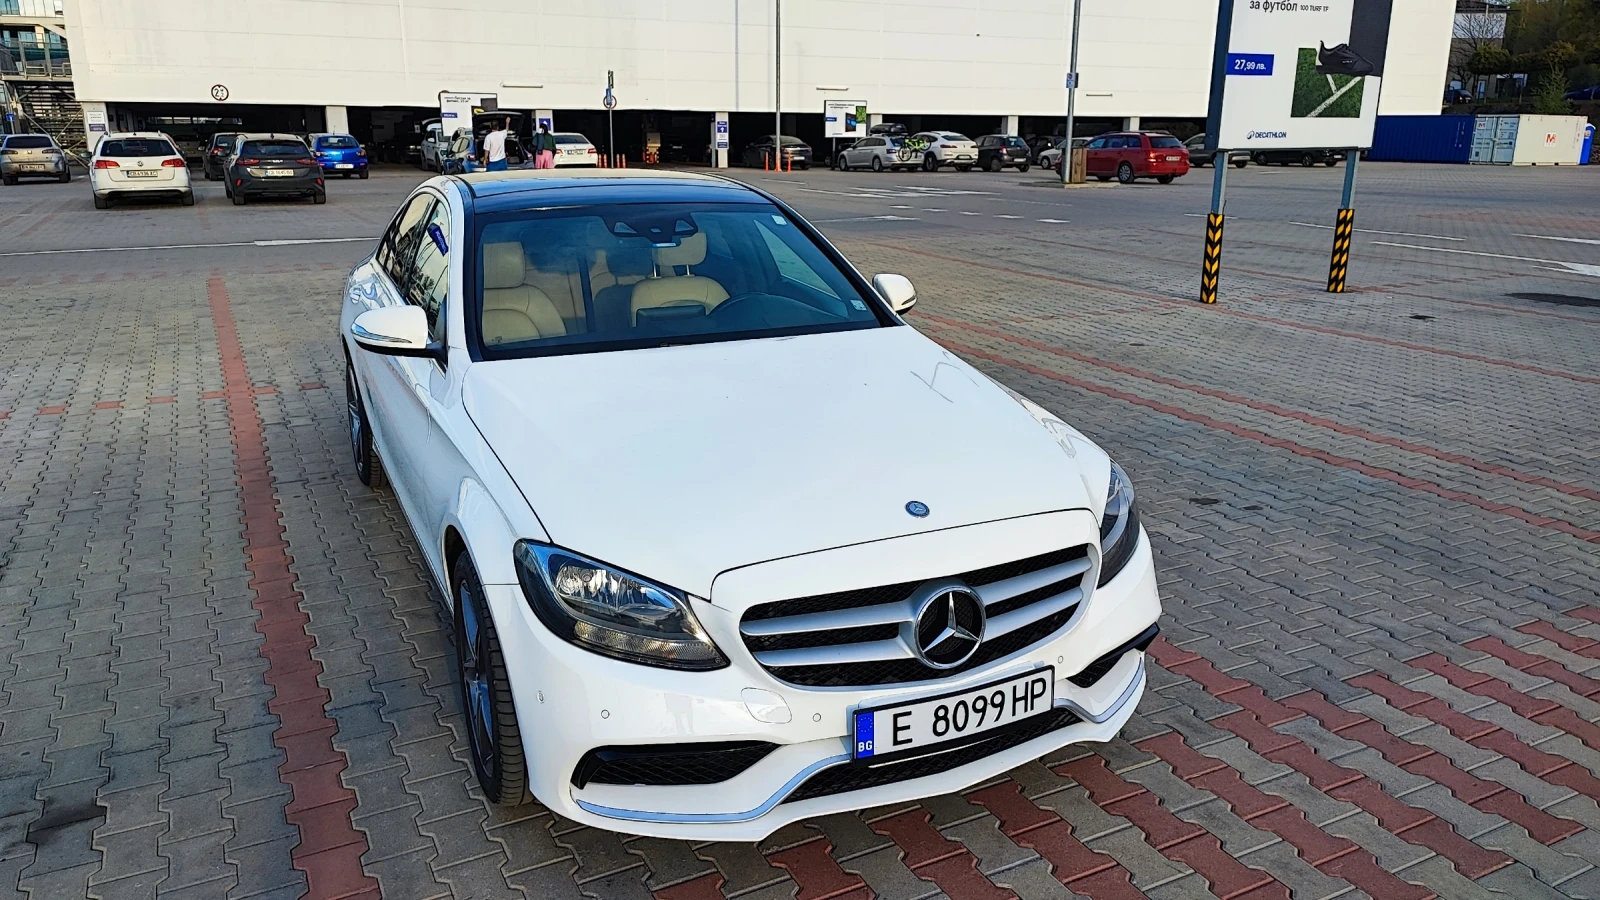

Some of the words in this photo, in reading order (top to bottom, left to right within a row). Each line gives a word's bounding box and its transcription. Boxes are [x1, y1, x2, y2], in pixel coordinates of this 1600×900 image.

[1249, 1, 1260, 9] за
[1262, 0, 1298, 13] футбол
[1234, 59, 1256, 71] 27,99
[1255, 131, 1287, 139] DECATHLON
[892, 710, 914, 747] E
[932, 690, 1006, 738] 8099
[1011, 677, 1047, 717] HP
[857, 740, 873, 752] BG
